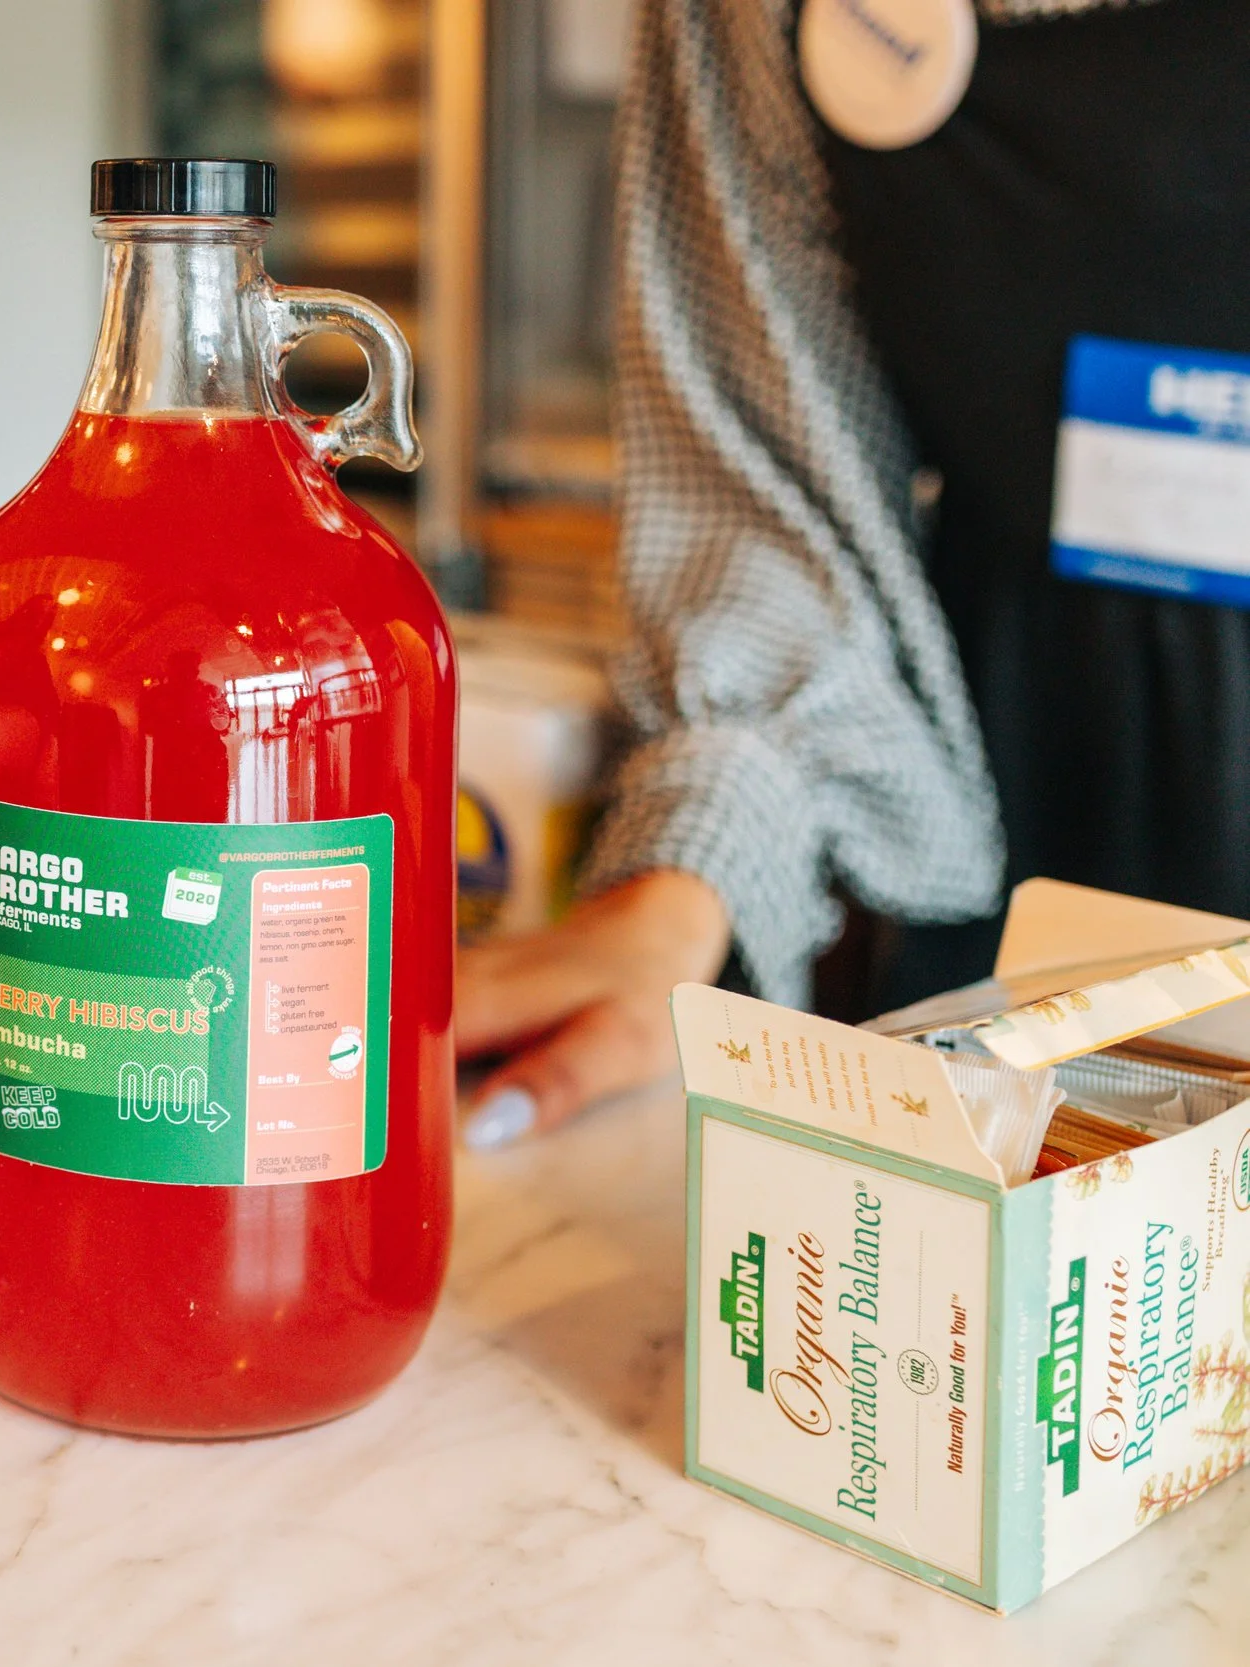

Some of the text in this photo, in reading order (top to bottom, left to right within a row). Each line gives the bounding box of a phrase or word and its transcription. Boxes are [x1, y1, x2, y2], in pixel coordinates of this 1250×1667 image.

[218, 846, 365, 863] @VARGOBROTHERFERMENTS
[188, 871, 213, 883] est.
[262, 878, 352, 893] Pertinent Facts
[175, 889, 216, 906] 2020
[262, 901, 323, 914] Ingredients
[23, 923, 33, 933] IL
[285, 917, 312, 927] organic
[313, 916, 333, 926] green
[301, 942, 317, 951] gmo
[318, 940, 335, 948] cane
[191, 964, 214, 983] good
[215, 967, 235, 995] things
[281, 983, 330, 994] live ferment
[281, 998, 306, 1009] vegan
[68, 998, 211, 1036] HIBISCUS
[280, 1009, 325, 1022] gluten free
[782, 1041, 790, 1055] tag
[799, 1036, 807, 1050] the
[3, 1057, 17, 1070] 12
[784, 1057, 792, 1071] the
[801, 1052, 810, 1068] and
[257, 1073, 300, 1085] Best By
[1, 1085, 57, 1107] KEEP
[1, 1106, 61, 1130] COLD
[256, 1120, 296, 1131] Lot No.
[294, 1154, 321, 1164] School
[1202, 1147, 1222, 1292] Supports Healthy
[769, 1231, 850, 1436] Organic
[950, 1340, 966, 1364] for
[1122, 1220, 1174, 1476] Respiratory
[1087, 1254, 1138, 1463] Organic
[910, 1358, 925, 1386] 1982
[948, 1365, 965, 1404] Good
[837, 1330, 887, 1522] Respiratory
[947, 1406, 968, 1475] Naturally
